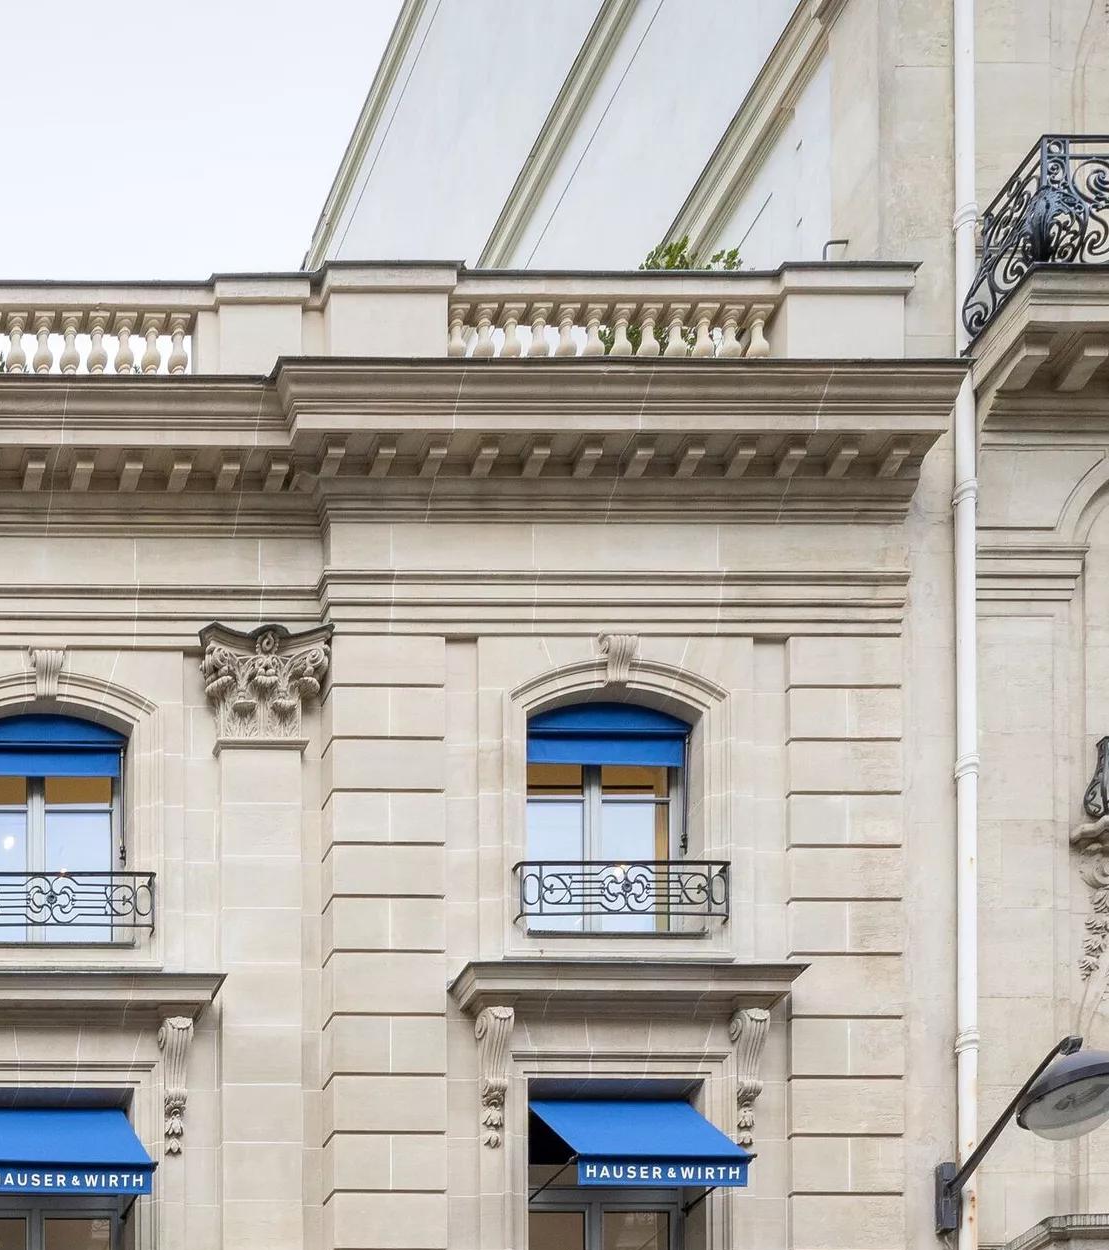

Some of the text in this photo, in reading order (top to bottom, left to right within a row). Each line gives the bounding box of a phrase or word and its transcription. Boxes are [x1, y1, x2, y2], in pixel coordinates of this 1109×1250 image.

[71, 1172, 81, 1188] &
[84, 1171, 144, 1188] WIRTH
[586, 1164, 740, 1180] HAUSER & WIRTH
